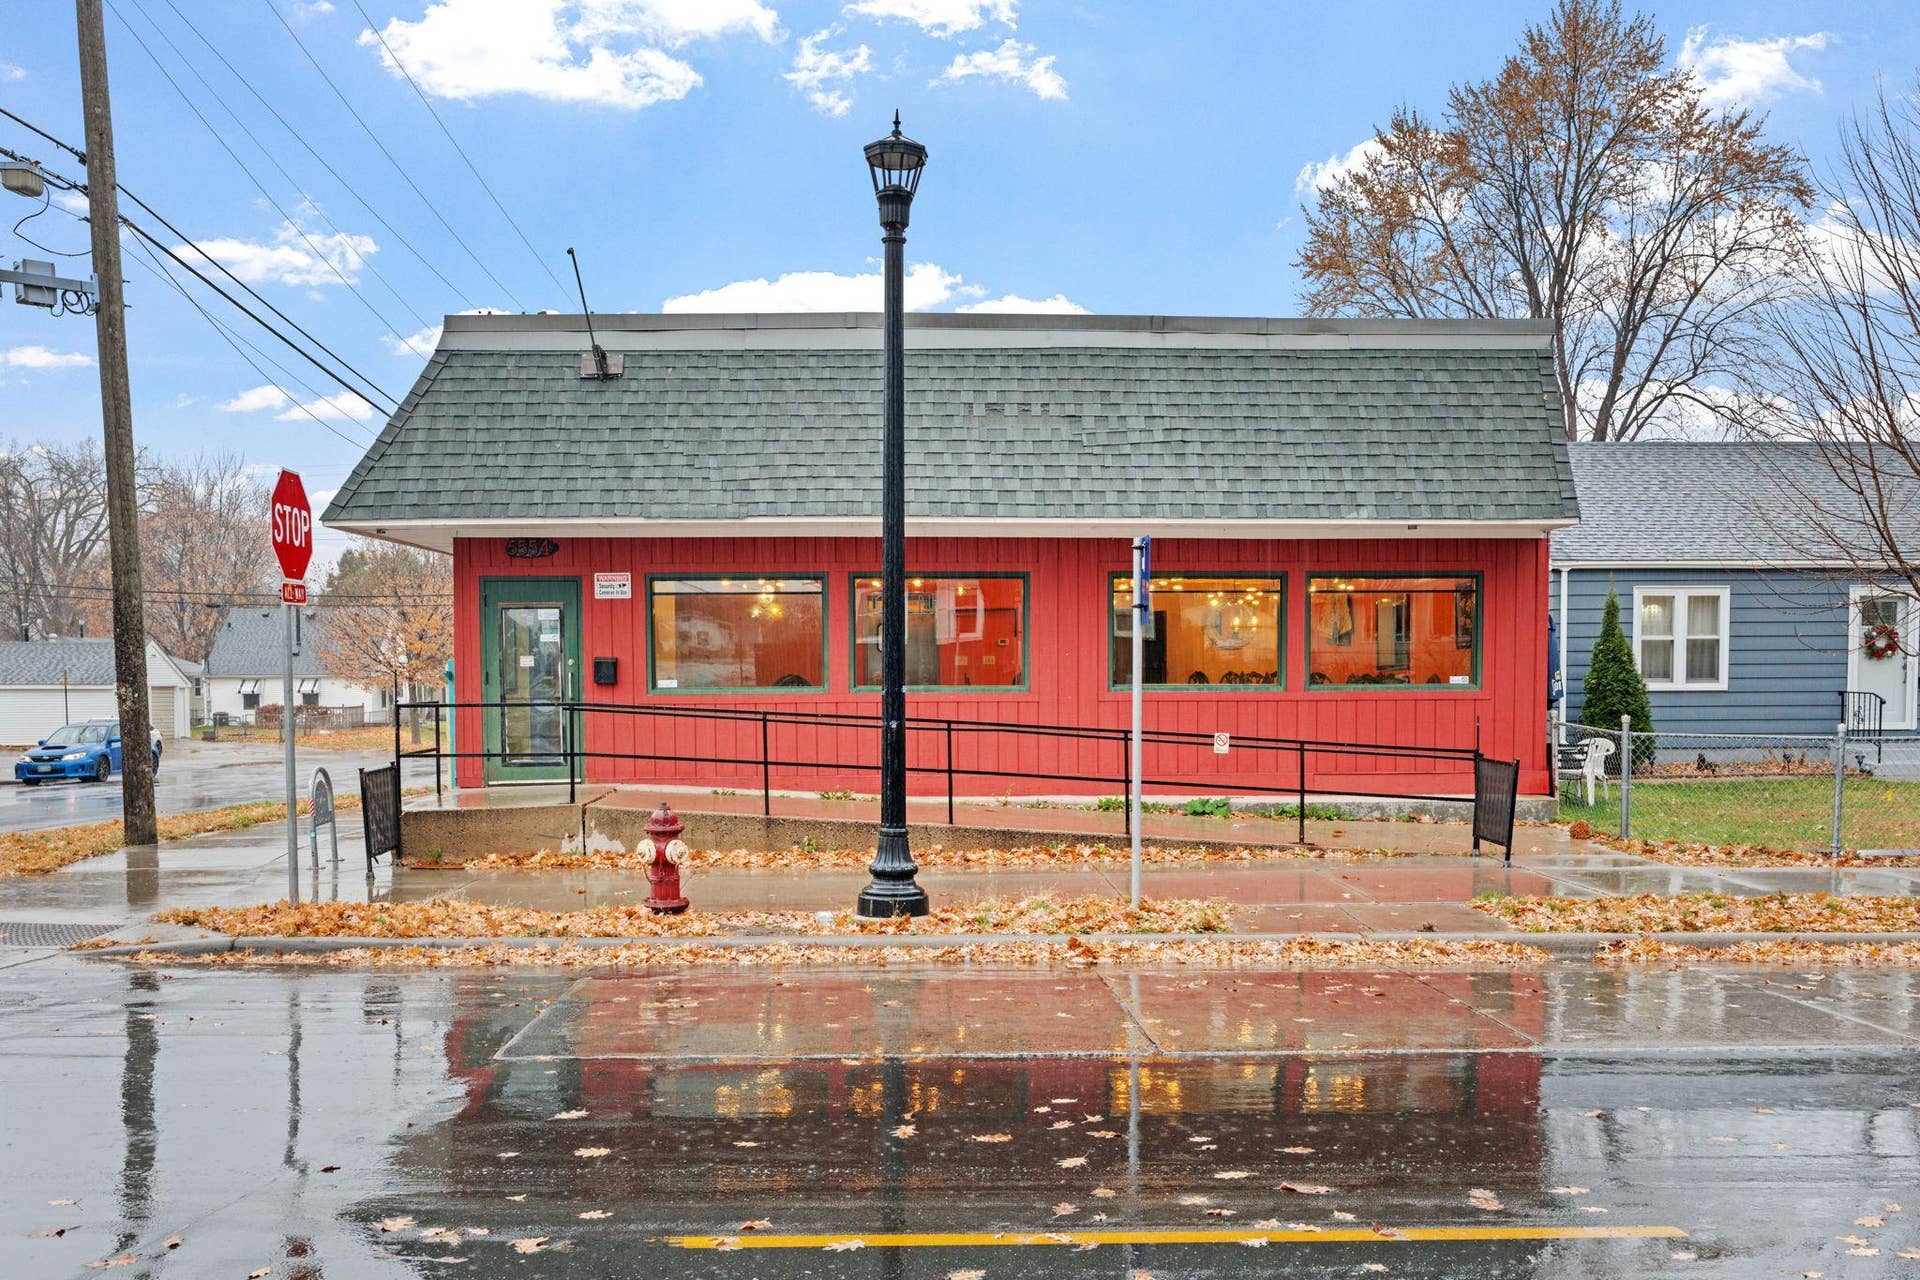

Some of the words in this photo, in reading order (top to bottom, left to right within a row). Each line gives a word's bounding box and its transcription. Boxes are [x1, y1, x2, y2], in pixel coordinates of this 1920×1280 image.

[274, 502, 309, 548] STOP
[284, 587, 294, 600] ALL
[295, 587, 305, 600] WAY
